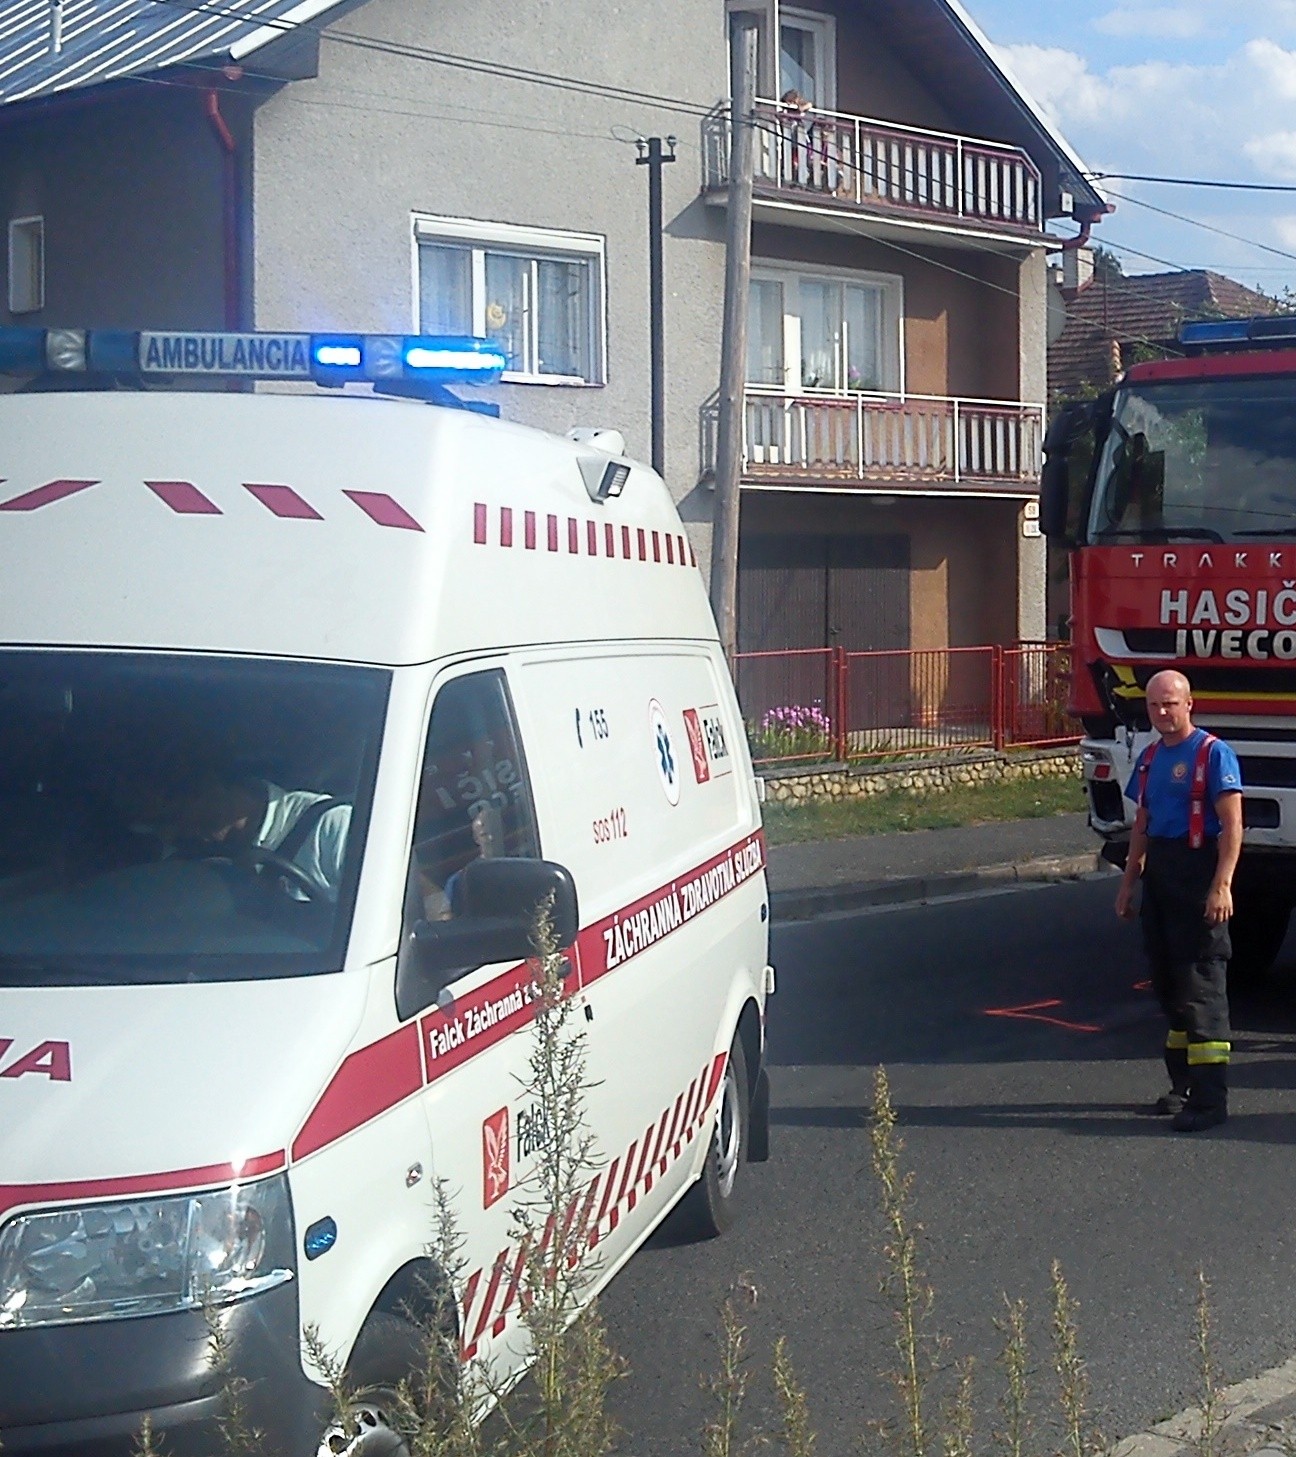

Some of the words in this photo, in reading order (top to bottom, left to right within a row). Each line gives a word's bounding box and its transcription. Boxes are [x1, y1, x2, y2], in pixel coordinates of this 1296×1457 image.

[148, 336, 309, 372] AMBULANCIA
[589, 708, 608, 740] 155
[610, 806, 627, 840] 112
[603, 883, 682, 970] ZÁCHRANNÁ
[680, 850, 736, 921] ZDRAVOTNÁ
[734, 837, 763, 884] SLUŽBA
[429, 1017, 466, 1060] Falck
[464, 983, 524, 1039] Záchranná
